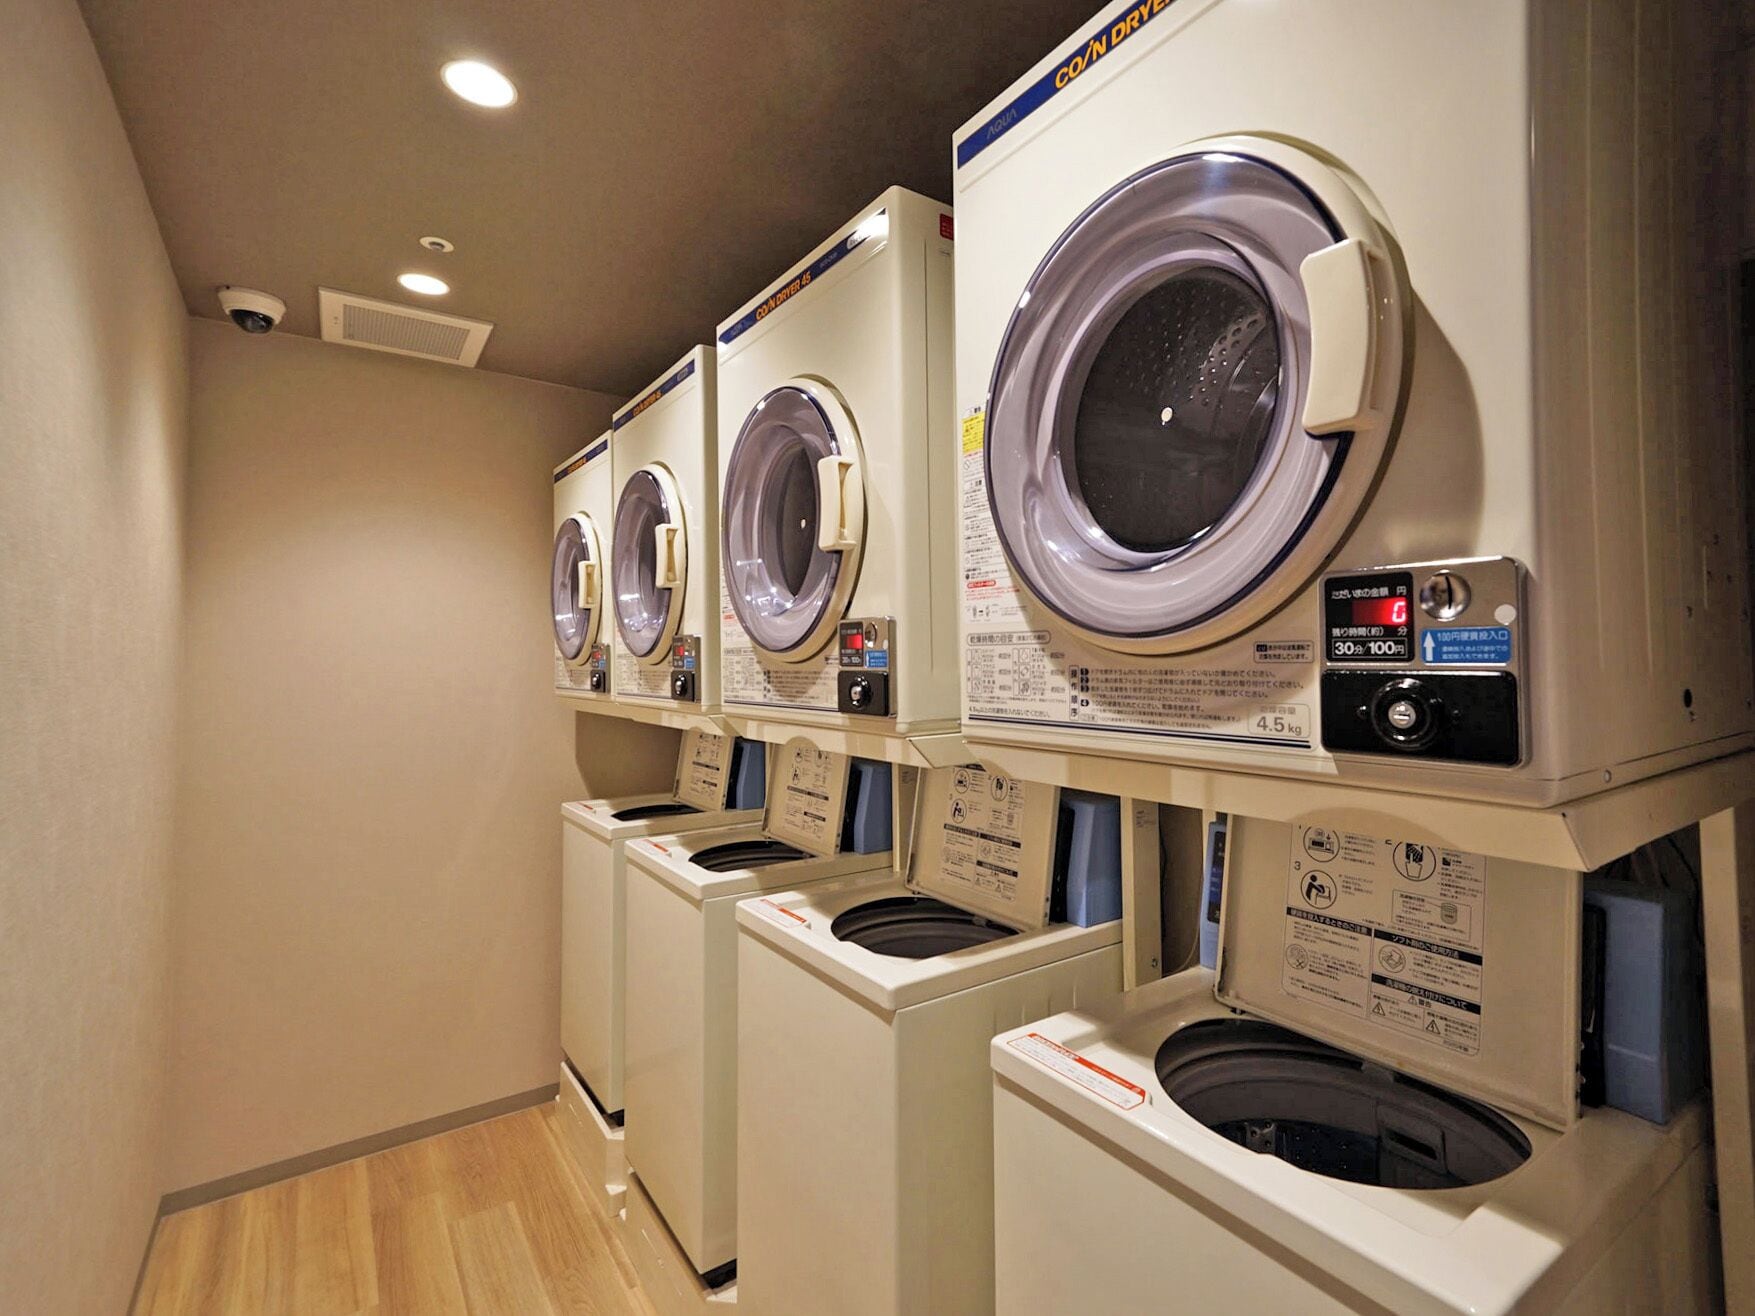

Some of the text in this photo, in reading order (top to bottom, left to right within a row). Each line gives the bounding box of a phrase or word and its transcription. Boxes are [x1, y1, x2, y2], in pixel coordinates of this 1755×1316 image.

[1111, 0, 1172, 47] DRYE
[986, 107, 1018, 140] AQUA
[776, 279, 801, 305] DRYER
[801, 271, 811, 286] 45
[1396, 585, 1408, 596] 円
[1397, 626, 1408, 637] 分
[1437, 631, 1509, 642] 100円硬貨投入口
[1334, 641, 1405, 655] 30分/100円
[1256, 716, 1302, 736] 4.5 kg
[1294, 861, 1301, 871] 3
